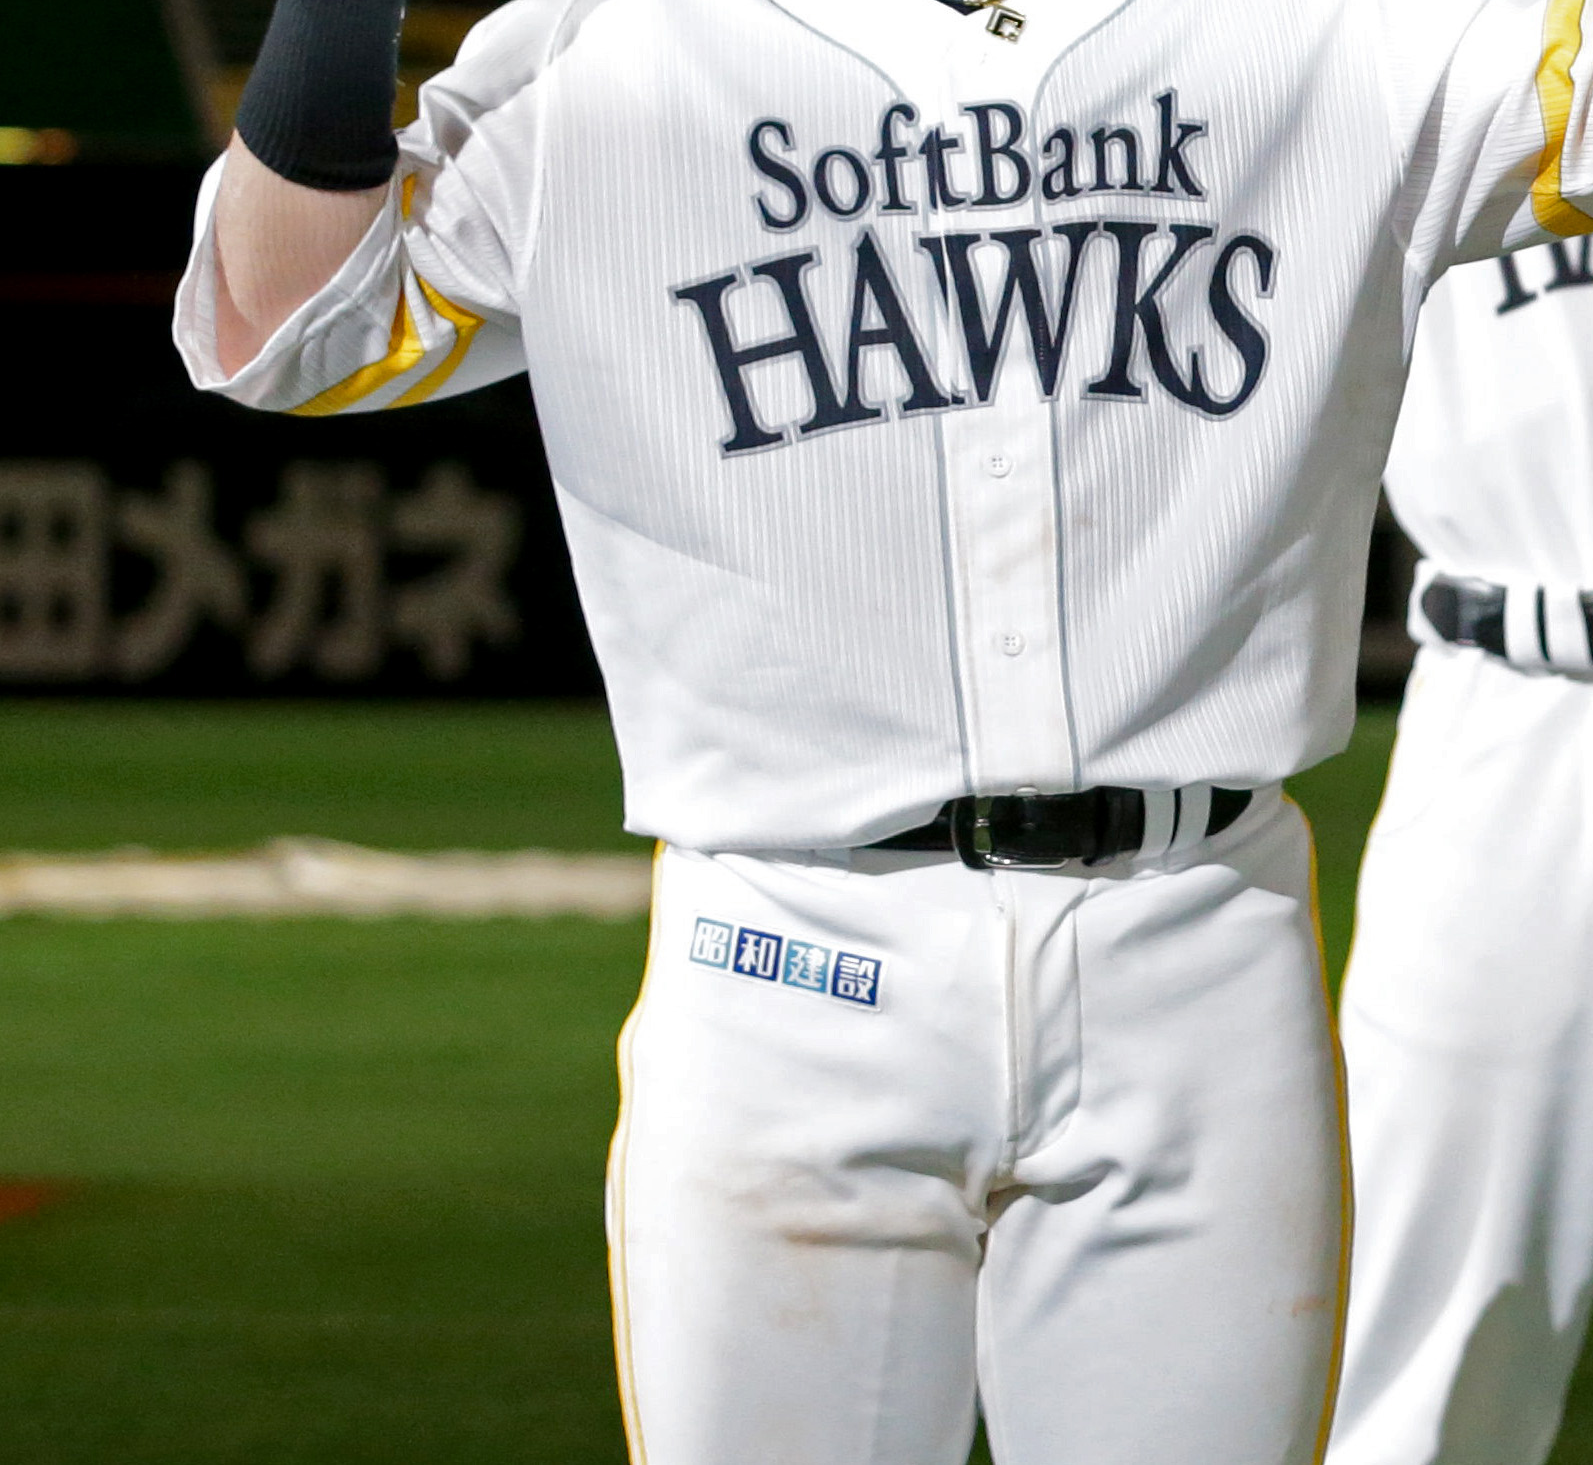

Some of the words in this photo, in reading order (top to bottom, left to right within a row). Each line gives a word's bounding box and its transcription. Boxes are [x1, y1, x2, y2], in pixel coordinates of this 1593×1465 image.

[746, 86, 1209, 234] SoftBank
[668, 215, 1281, 459] HAWKS
[690, 920, 878, 1003] 昭和建設
